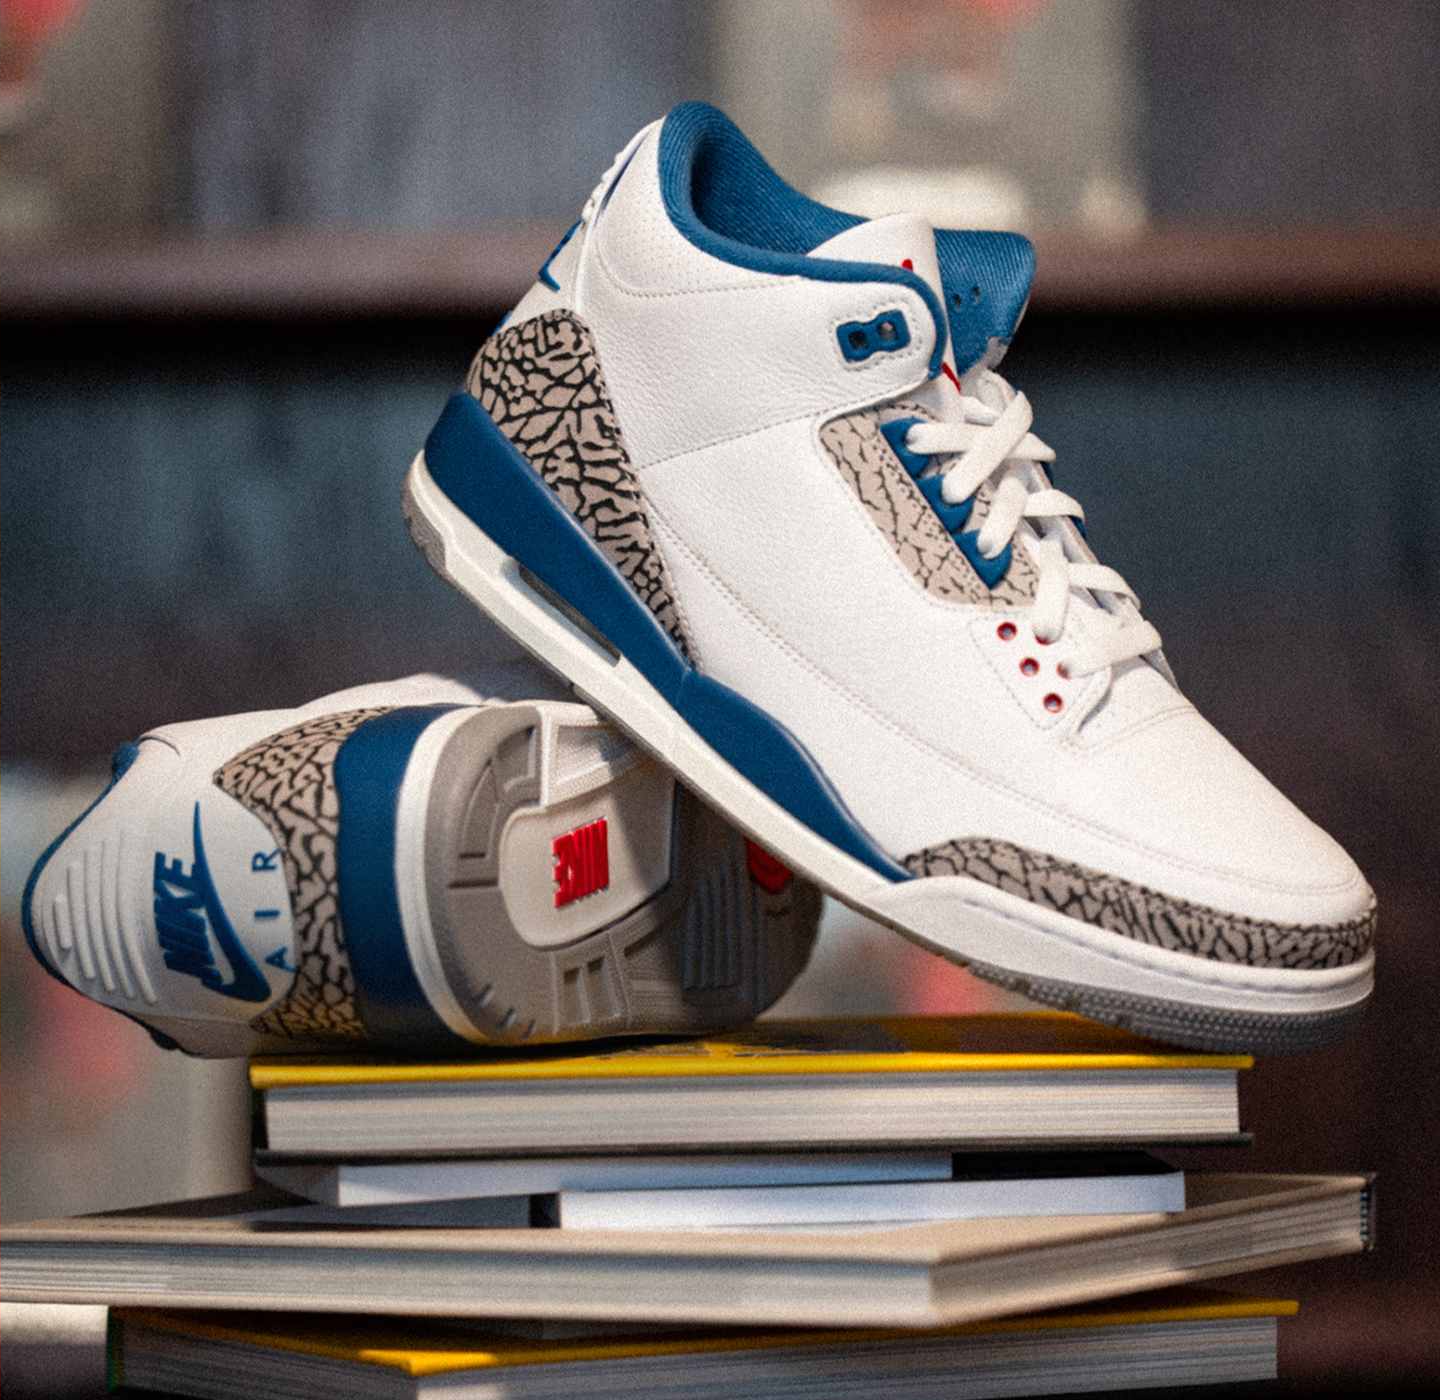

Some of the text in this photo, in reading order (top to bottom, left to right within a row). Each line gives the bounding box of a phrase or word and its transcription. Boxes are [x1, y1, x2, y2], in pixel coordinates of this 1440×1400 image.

[153, 851, 224, 988] NIKE
[251, 848, 298, 973] AIR
[551, 816, 609, 910] NIKE
